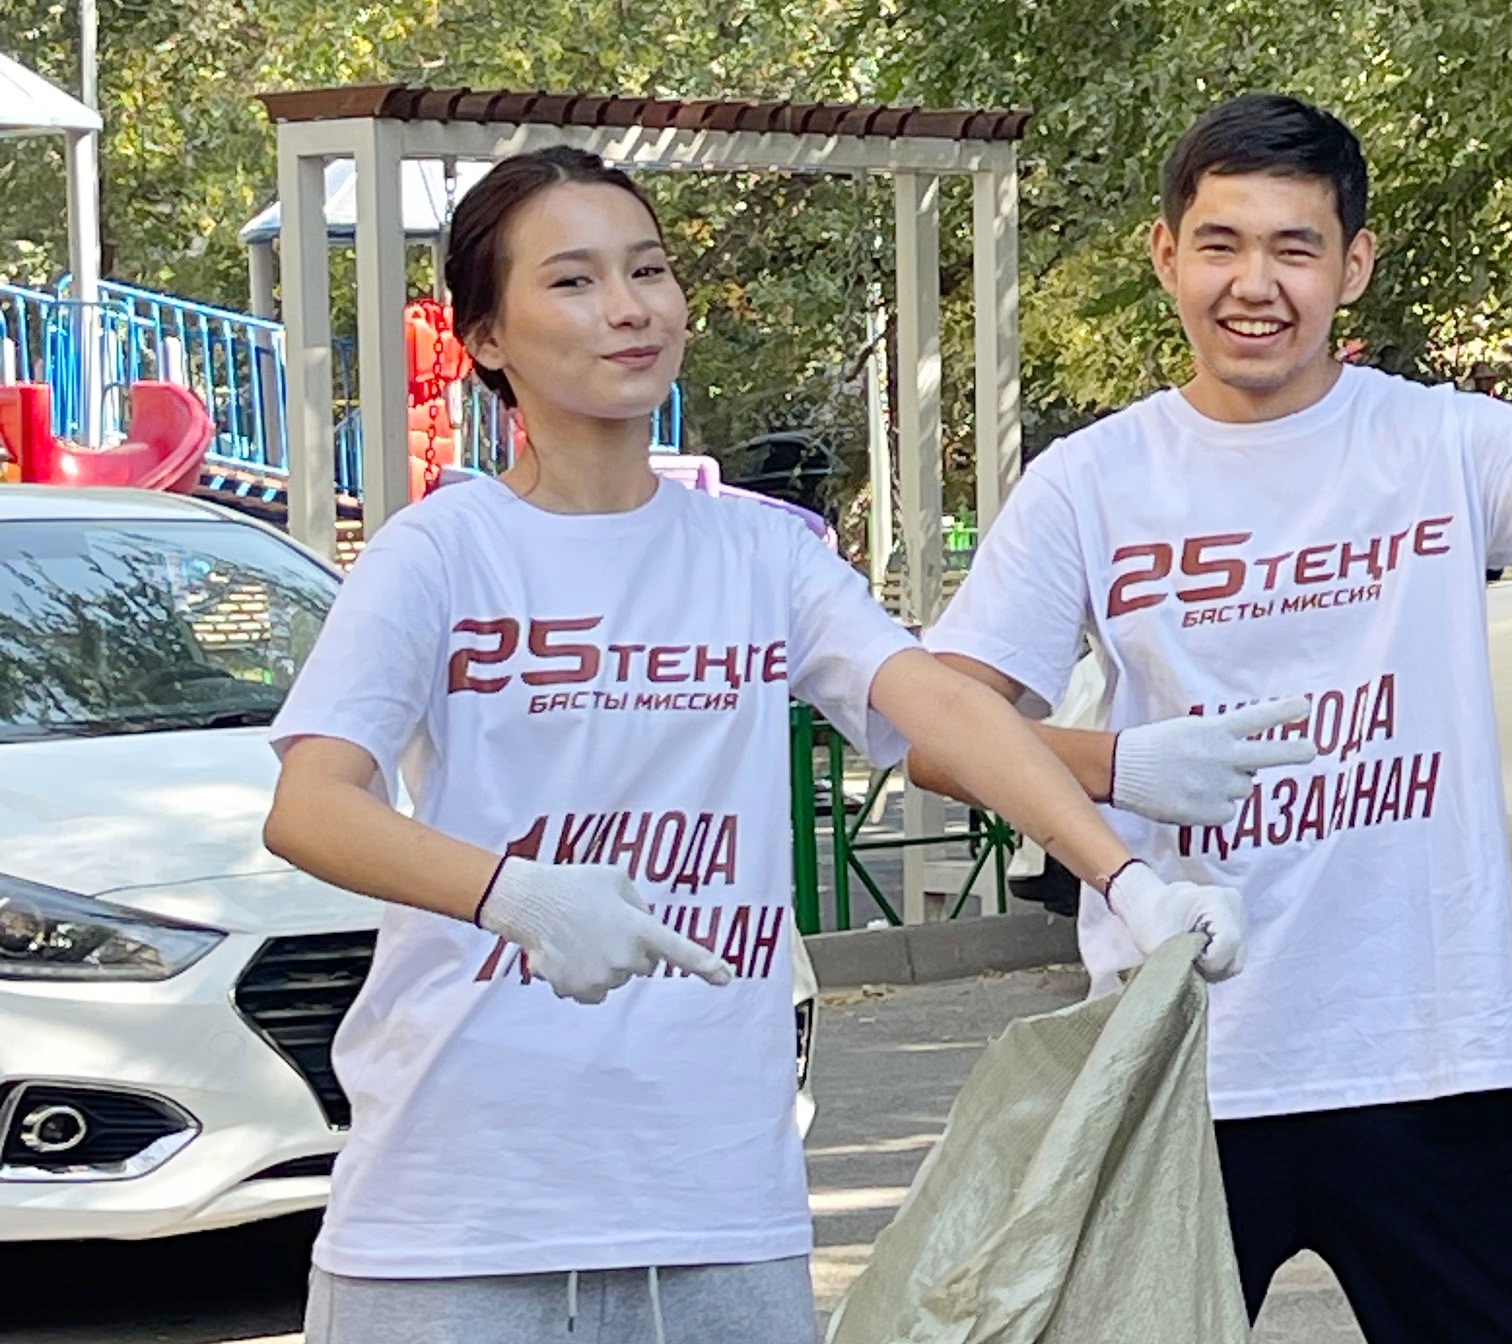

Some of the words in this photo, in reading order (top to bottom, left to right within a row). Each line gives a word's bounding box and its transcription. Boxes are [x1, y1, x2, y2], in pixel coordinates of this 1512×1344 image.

[1105, 532, 1253, 619] 25
[1181, 599, 1273, 628] БАСТЫ
[1280, 583, 1382, 615] МИССИЯ
[447, 615, 604, 696] 25
[528, 691, 628, 715] БАСТЫ
[634, 692, 738, 713] МИССИЯ
[553, 810, 738, 895] КИНОДА
